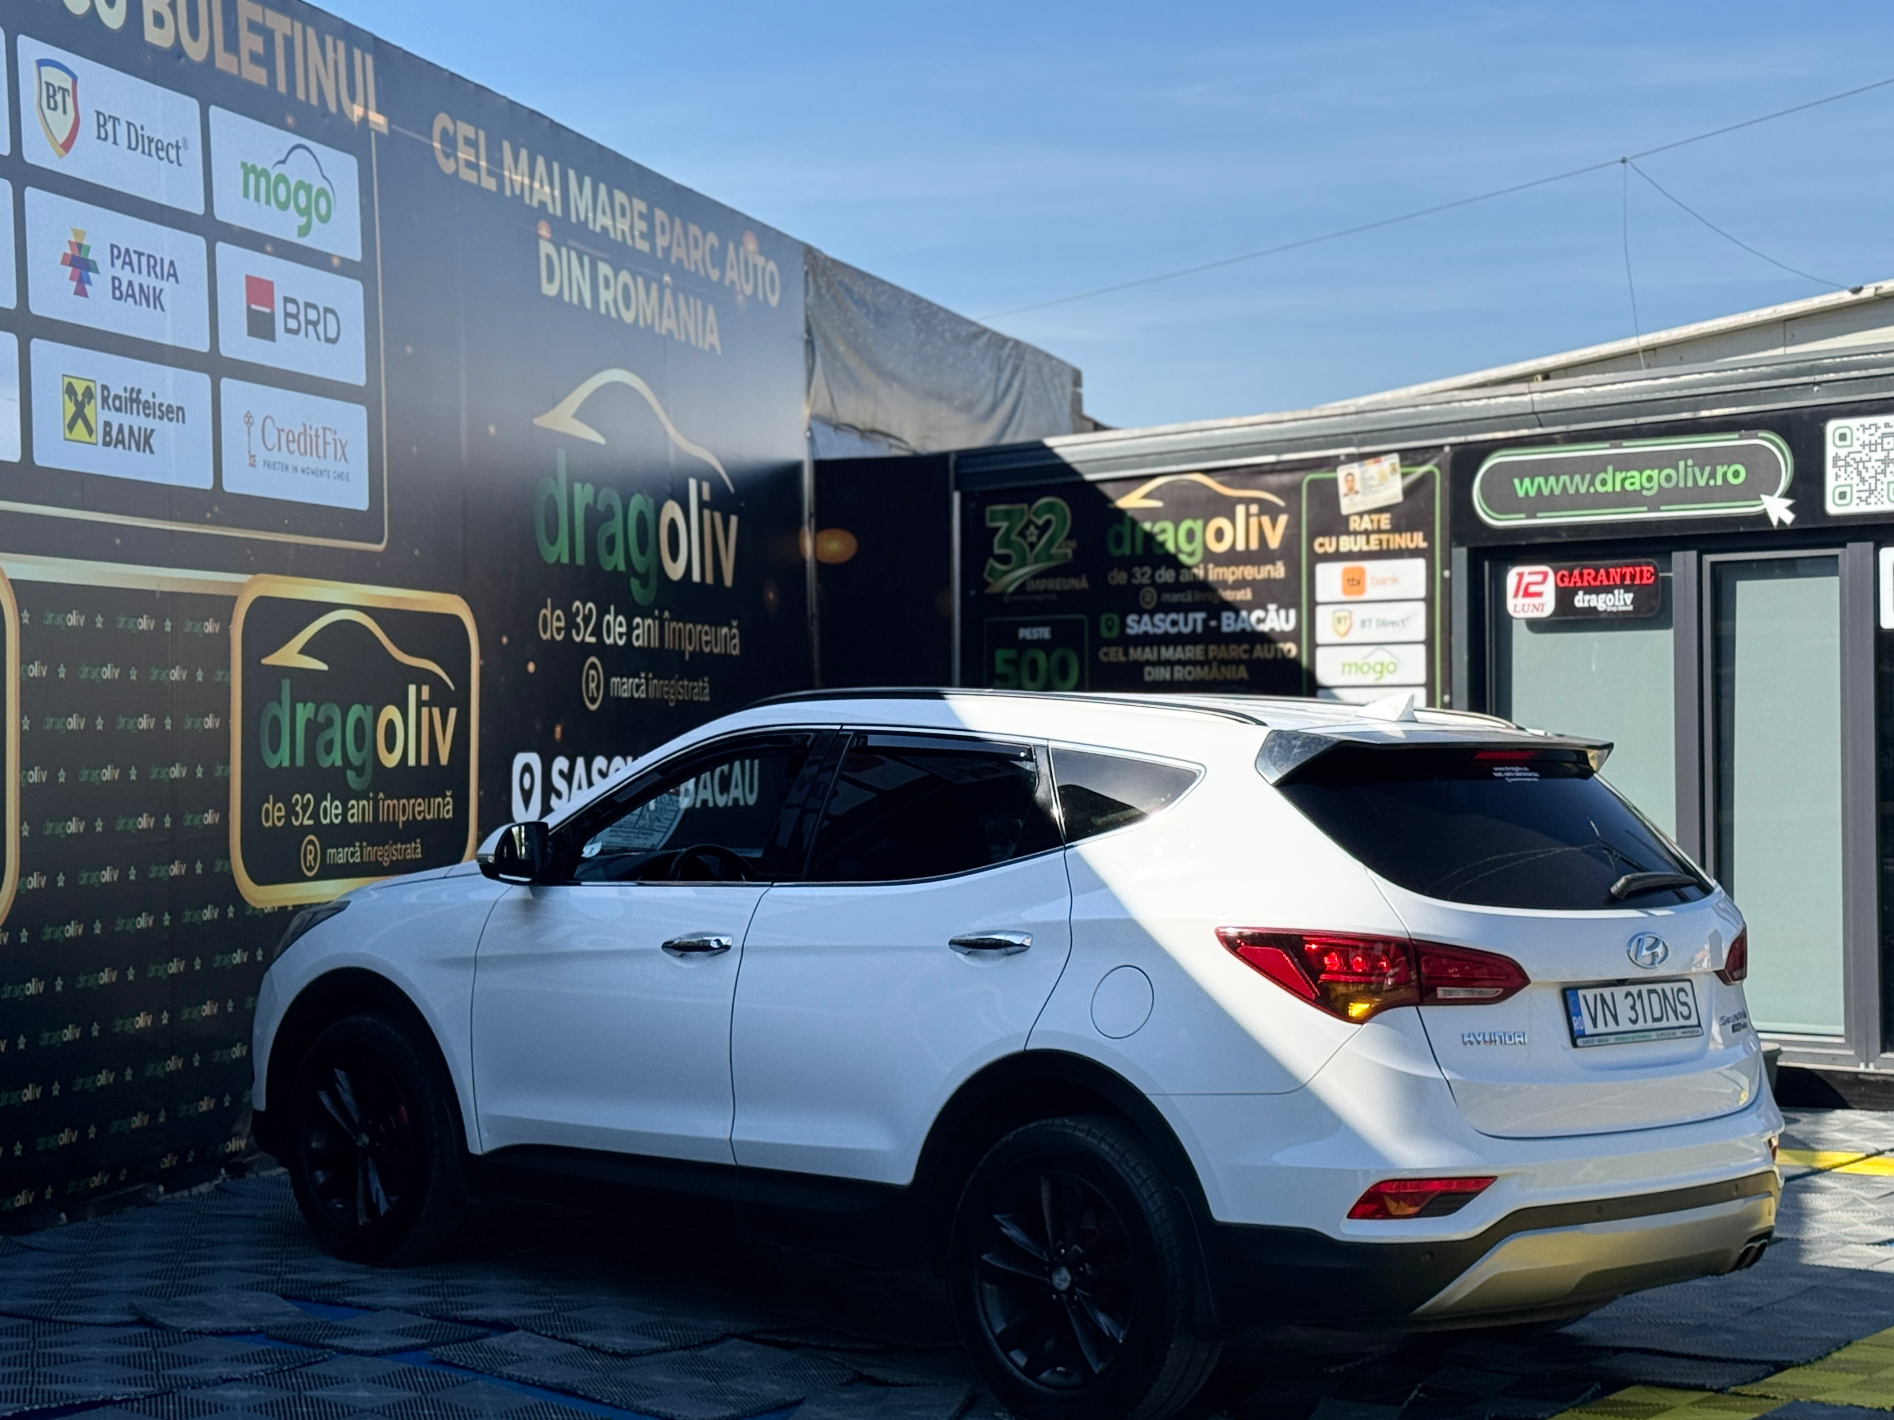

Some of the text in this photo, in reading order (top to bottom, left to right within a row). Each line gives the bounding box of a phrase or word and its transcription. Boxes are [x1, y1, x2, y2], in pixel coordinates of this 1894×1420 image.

[143, 0, 388, 135] BULETINUL
[44, 80, 70, 116] BT
[94, 109, 121, 146] BT
[240, 160, 332, 238] mogo
[432, 112, 780, 307] CEL MAI MARE PARC AUTO
[109, 243, 180, 285] PATRIA
[111, 275, 165, 313] BANK
[538, 238, 722, 356] DIN ROMÂNIA
[283, 295, 341, 345] BRD
[100, 383, 186, 425] Raiffeisen
[102, 420, 155, 455] BANK
[261, 415, 349, 464] CreditFix
[263, 459, 289, 473] PRIETEN
[300, 465, 331, 479] MOMENTE
[333, 471, 350, 482] CHEIE
[1513, 458, 1747, 498] www.dragoliv.ro
[535, 449, 738, 605] dragoliv
[1106, 503, 1289, 567] dragoliv
[1349, 513, 1391, 532] RATE
[984, 496, 1073, 583] 32
[1313, 531, 1428, 554] CU BULETINUL
[1107, 561, 1285, 585] de 32 de ani împreună
[1370, 575, 1399, 587] bank
[1513, 570, 1549, 598] 12
[1556, 565, 1655, 587] GARANTIE
[1513, 603, 1545, 614] LUNI
[1574, 589, 1634, 611] dragoliv
[43, 609, 220, 636] dragoliv dragoliv dragoliv
[538, 598, 740, 660] de 32 de ani împreună
[1018, 626, 1051, 641] PESTE
[1125, 612, 1206, 635] SASCUT
[1221, 603, 1297, 633] BACĂU
[1099, 641, 1298, 662] CEL MAI MARE PARC AUTO
[20, 660, 187, 684] goliv dragoliv dragoliv
[610, 672, 646, 699] marcă
[993, 648, 1080, 691] 500
[1143, 666, 1171, 682] DIN
[1341, 661, 1398, 682] mogo
[43, 714, 220, 734] dragoliv dragoliv dragoliv
[260, 678, 457, 791] dragoliv
[20, 763, 187, 787] goliv dragoliv dragoliv
[43, 809, 220, 838] dragoliv dragoliv dragoliv
[261, 790, 453, 828] de 32 de ani împreună
[326, 842, 361, 865] marcă
[78, 866, 119, 887] dragoliv
[149, 860, 187, 879] dragoliv
[41, 904, 219, 942] dragoliv dragoliv dragoliv
[1, 948, 248, 1000] dragoliv dragoliv dragoliv dragoliv
[1573, 1016, 1585, 1031] RO
[1582, 991, 1620, 1029] VN
[1461, 1031, 1528, 1046] HYUNDAI
